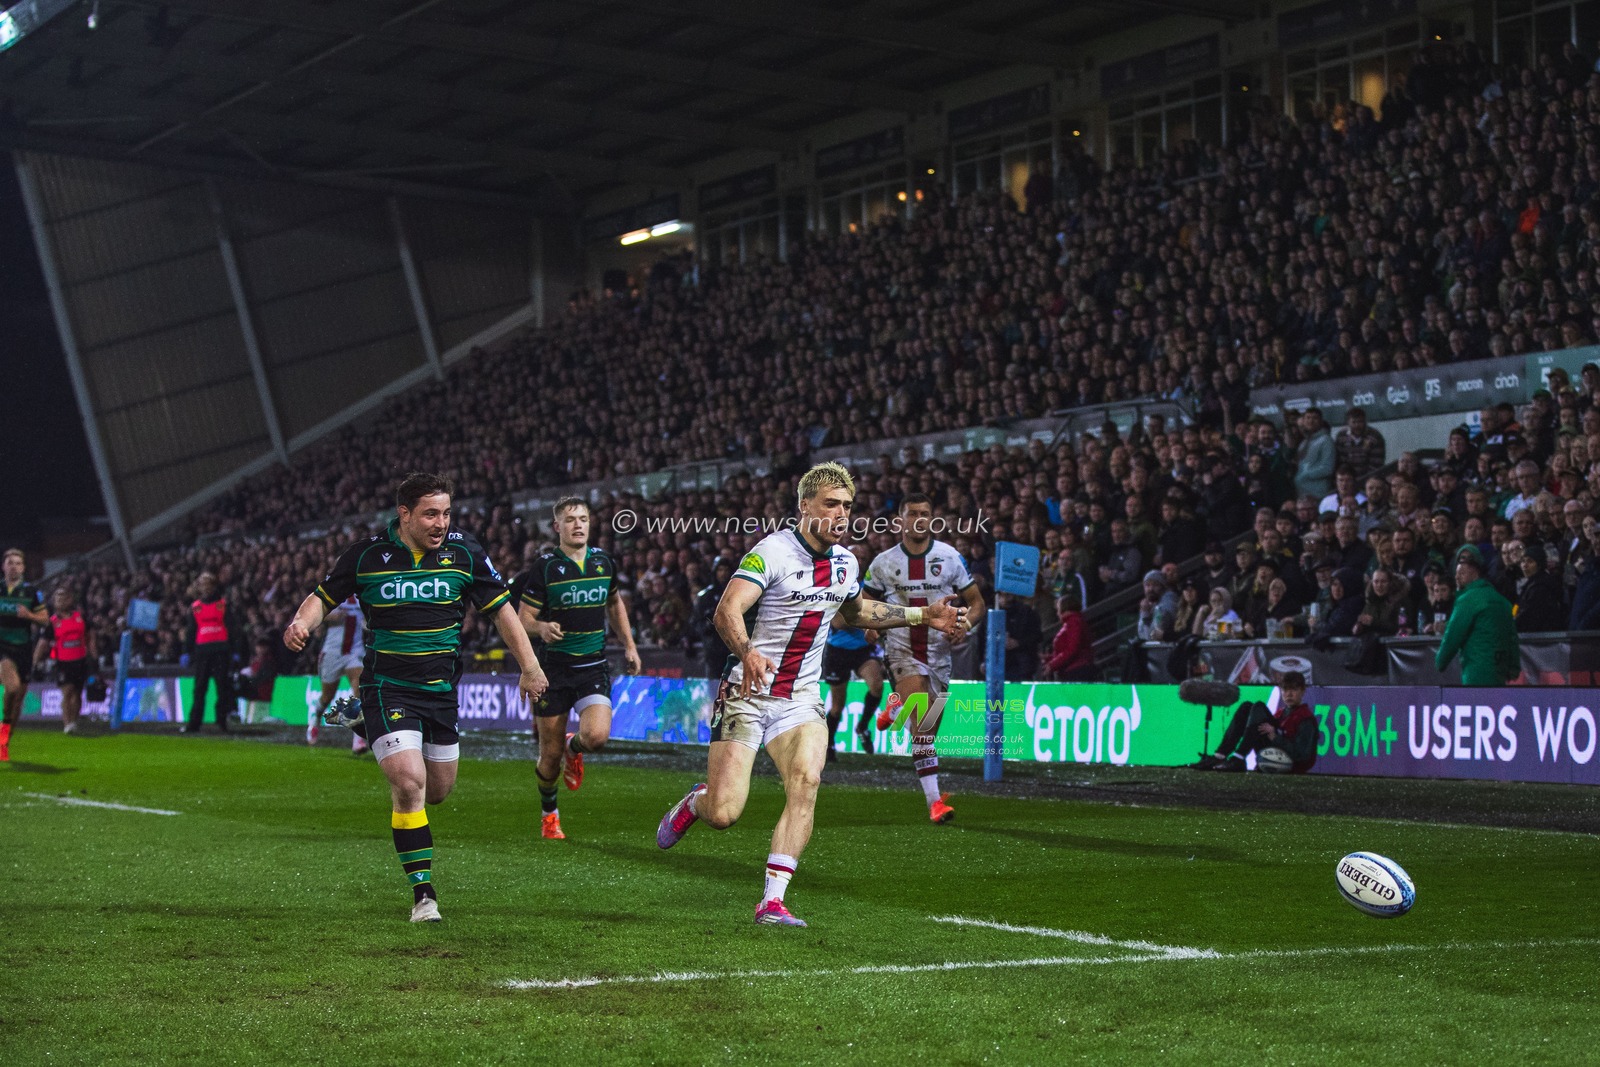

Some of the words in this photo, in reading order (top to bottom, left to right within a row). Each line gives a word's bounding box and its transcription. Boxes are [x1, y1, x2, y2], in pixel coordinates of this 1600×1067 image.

[380, 576, 450, 599] cinch
[560, 585, 608, 605] cinch
[790, 590, 824, 602] Topps
[824, 591, 845, 603] Tiles
[894, 583, 921, 591] Topps
[921, 582, 942, 591] Tiles
[457, 684, 501, 719] USERS
[1316, 704, 1398, 758] 38M+
[1408, 704, 1518, 762] USERS
[1533, 705, 1598, 765] WO
